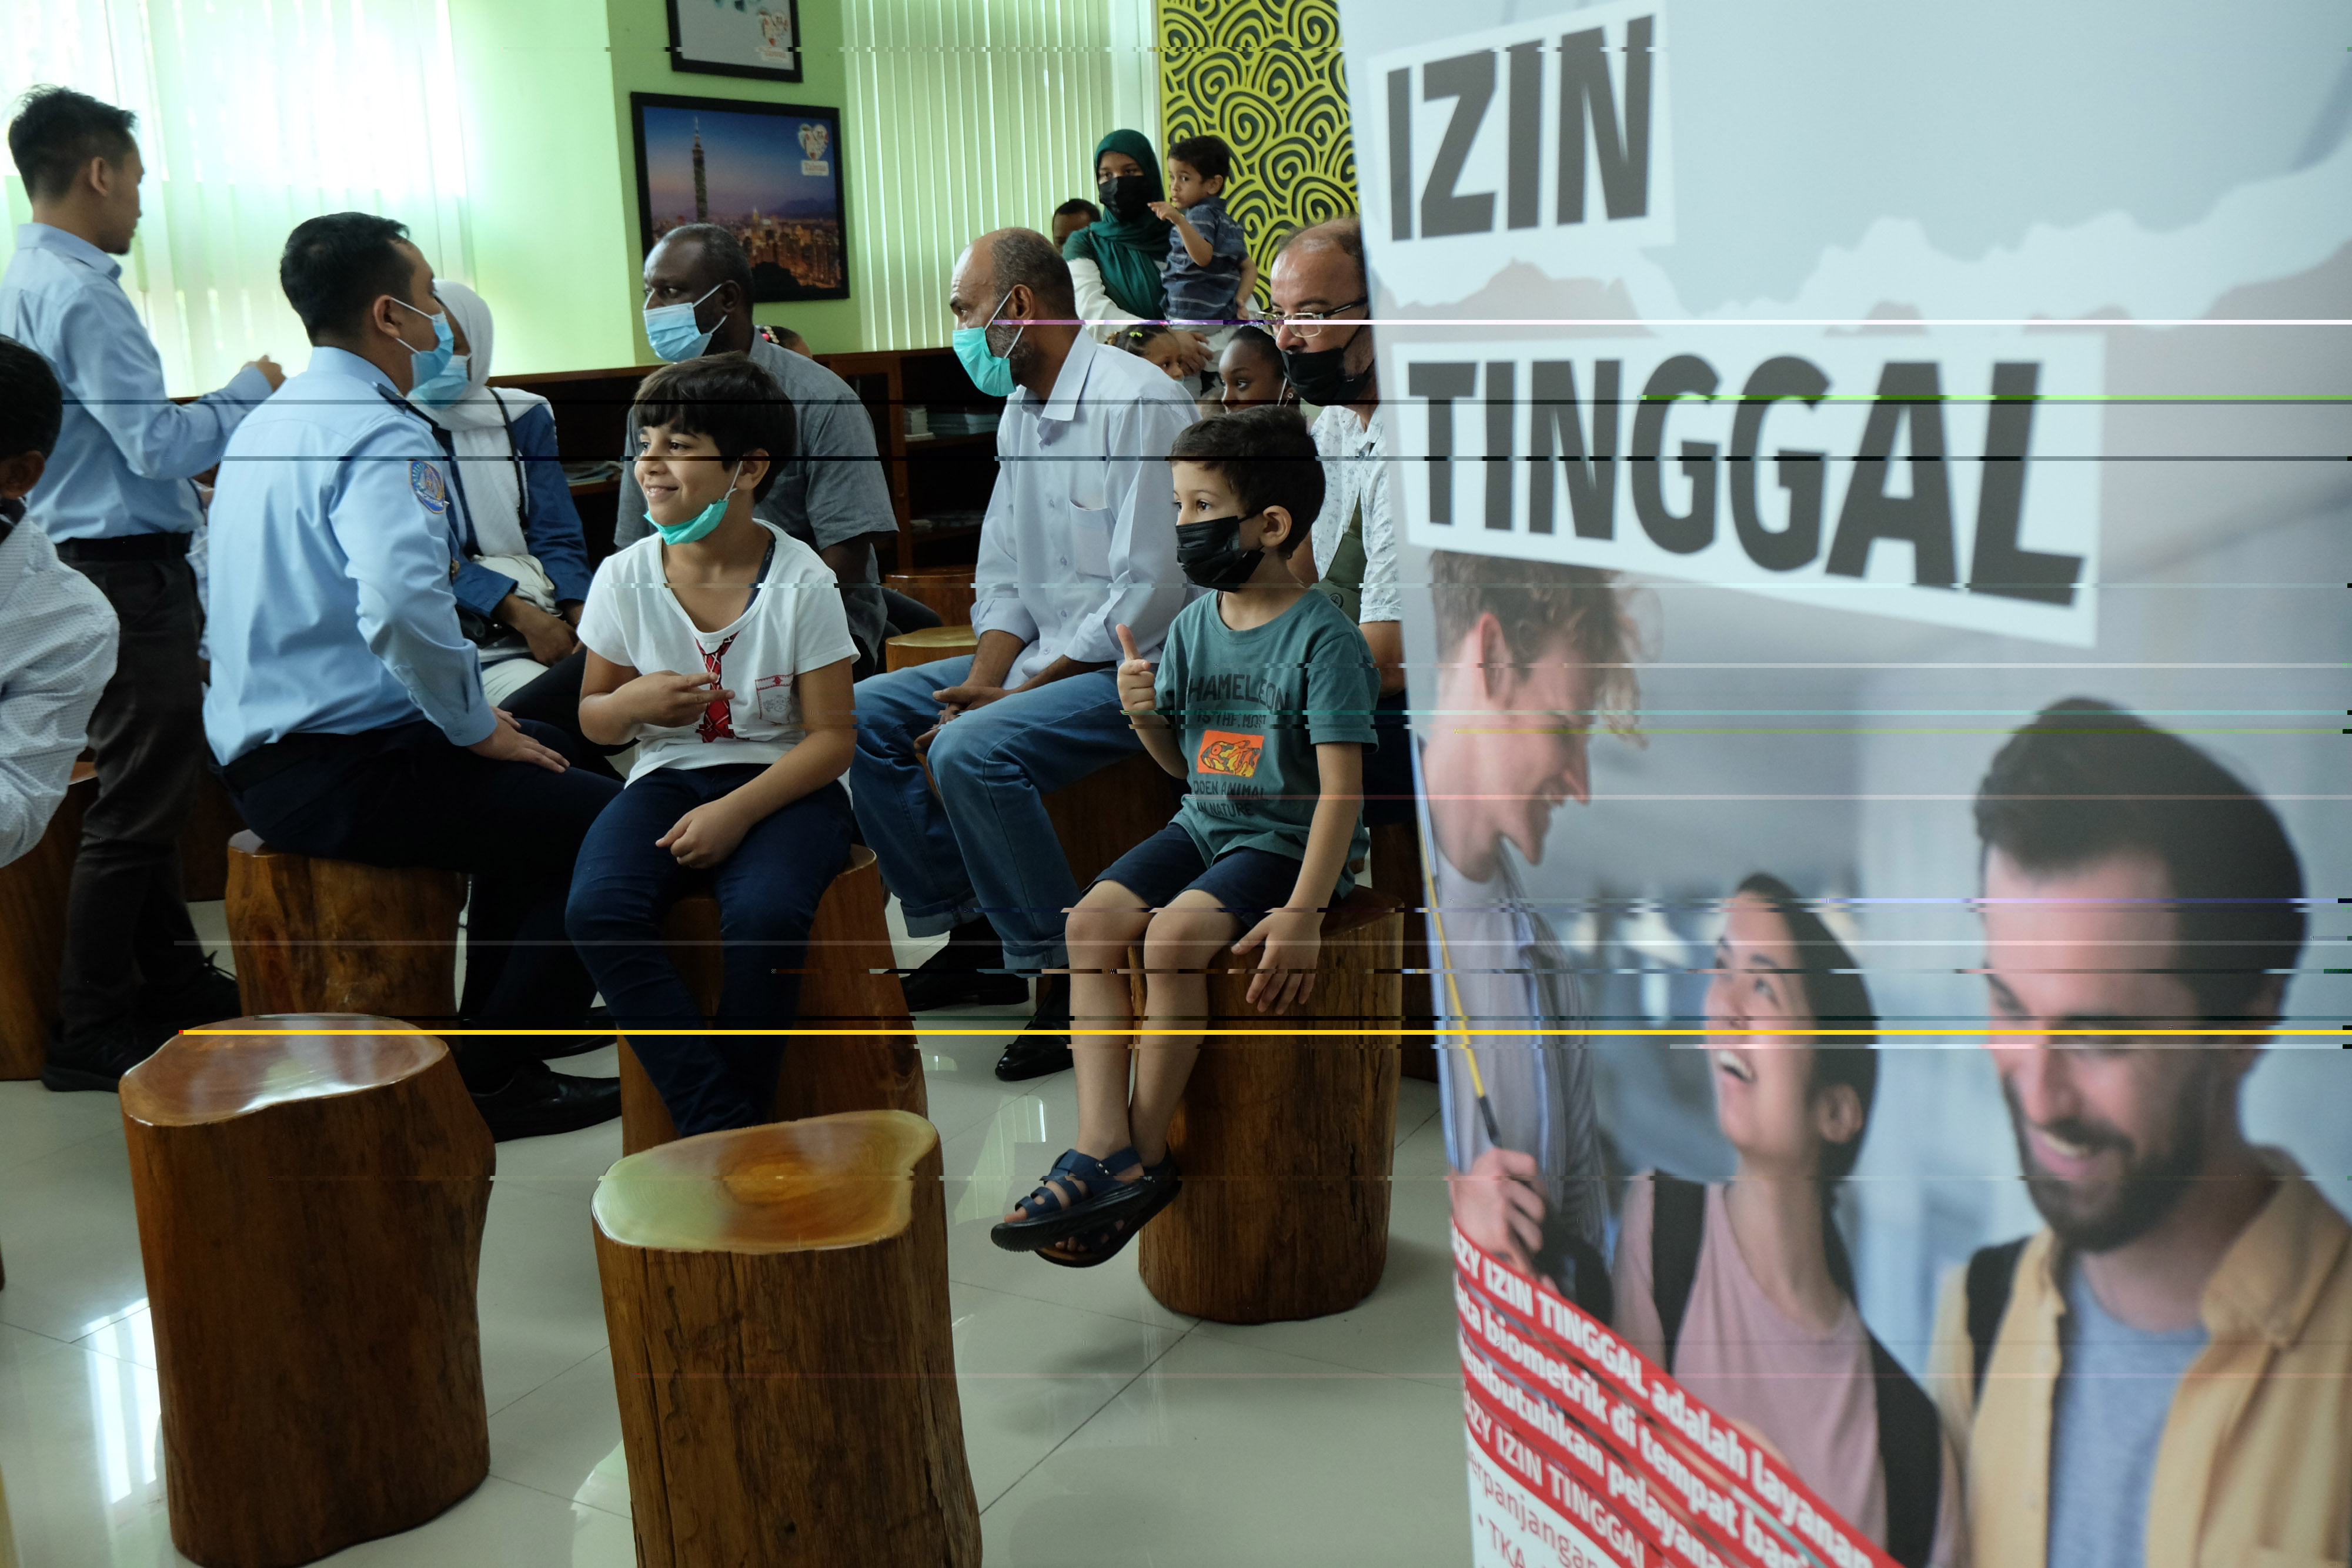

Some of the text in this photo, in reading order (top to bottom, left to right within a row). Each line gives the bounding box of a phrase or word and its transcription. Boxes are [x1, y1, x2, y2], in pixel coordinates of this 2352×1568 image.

[1386, 14, 1655, 242] IZIN
[1406, 352, 2087, 607] TINGGAL
[1214, 711, 1239, 727] THE
[1239, 713, 1267, 728] MOST
[1221, 781, 1268, 800] ANIMAL
[1209, 802, 1254, 817] NATURE
[1484, 1256, 1534, 1317] IZIN
[1535, 1289, 1649, 1399] TINGGAL
[1651, 1379, 1747, 1479] adalah
[1484, 1306, 1609, 1424] biometrik
[1610, 1402, 1637, 1448] di
[1639, 1425, 1740, 1539] tempat
[1495, 1425, 1543, 1486] IZIN
